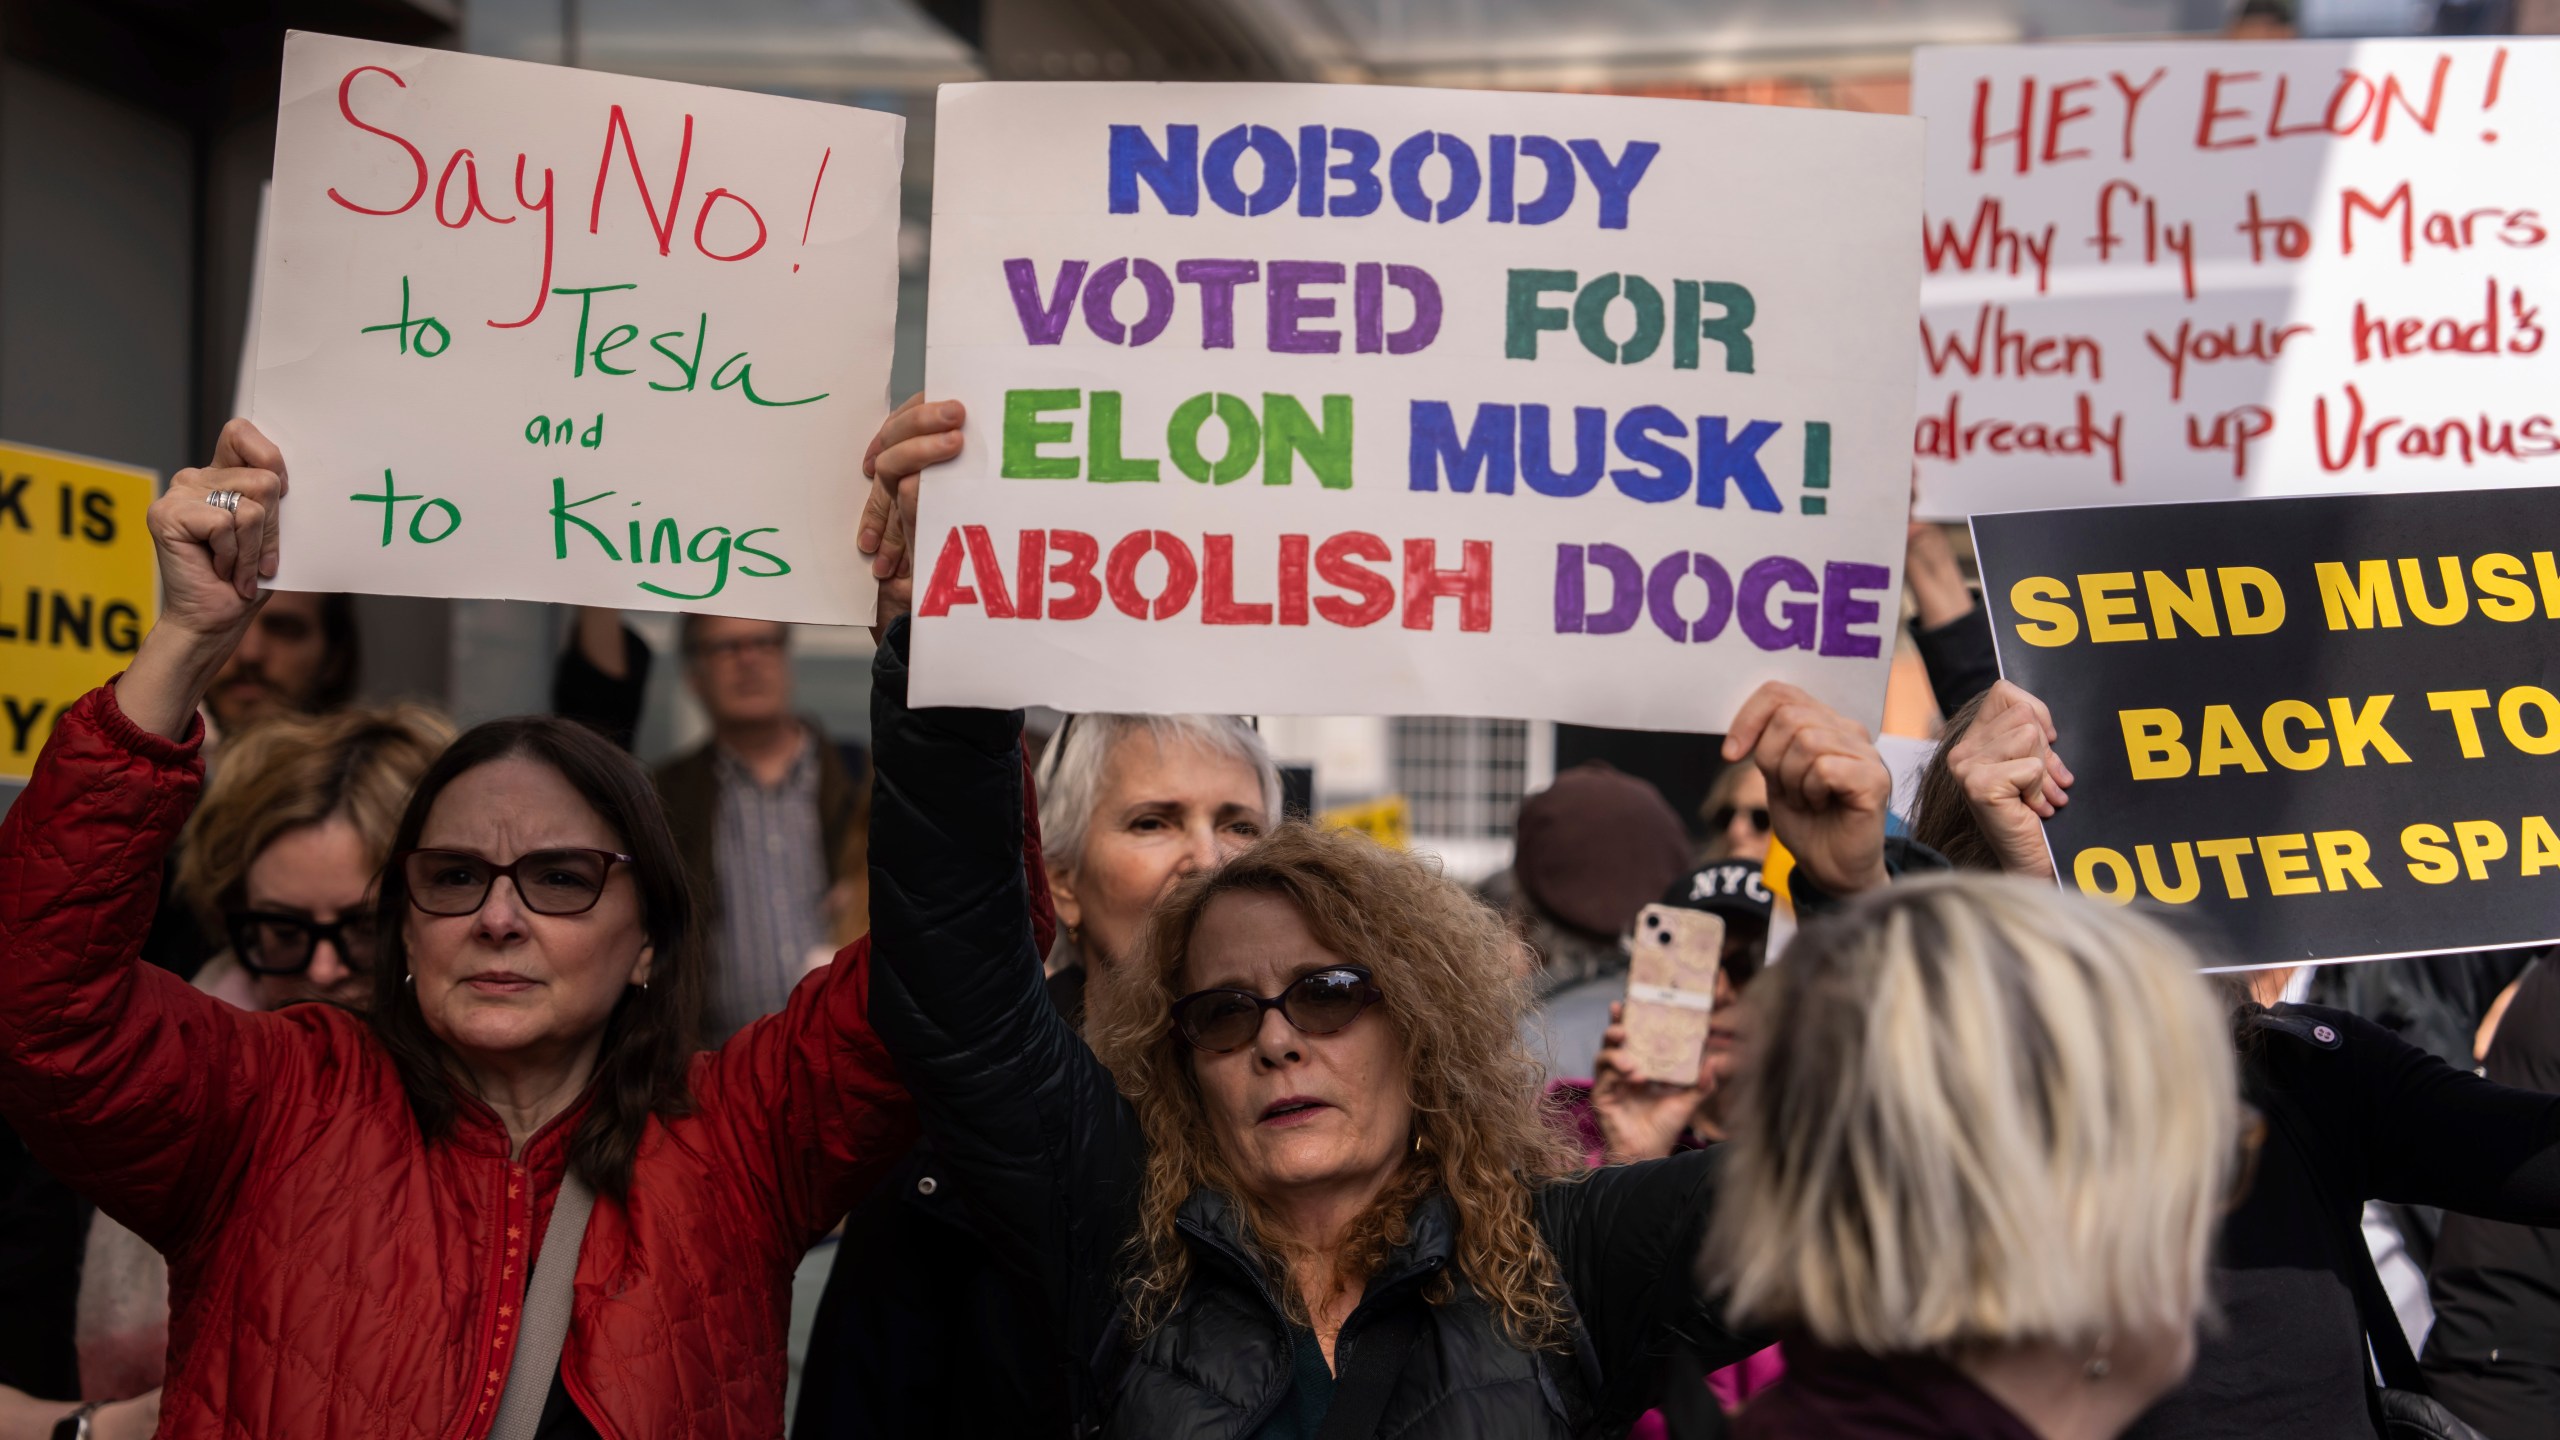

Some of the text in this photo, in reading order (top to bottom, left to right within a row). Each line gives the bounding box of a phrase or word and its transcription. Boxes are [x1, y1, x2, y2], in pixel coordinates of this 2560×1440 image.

[1968, 46, 2509, 174] HEY ELON!
[326, 64, 832, 329] Say No!
[1108, 123, 1661, 230] NOBODY
[1922, 178, 2548, 301] Why fly to Mars
[360, 275, 832, 407] to Tesla
[1002, 256, 1757, 376] VOTED FOR
[1917, 276, 2546, 403] When your head's
[525, 412, 605, 451] and
[1000, 388, 1832, 517] ELON MUSK!
[1914, 383, 2560, 486] already up Uranus
[60, 482, 117, 543] IS
[350, 468, 793, 602] to Kings
[917, 523, 1891, 660] ABOLISH DOGE
[2009, 564, 2287, 648] SEND
[2118, 685, 2560, 781] BACK TO
[1688, 865, 1772, 904] NYC
[2073, 829, 2384, 908] OUTER
